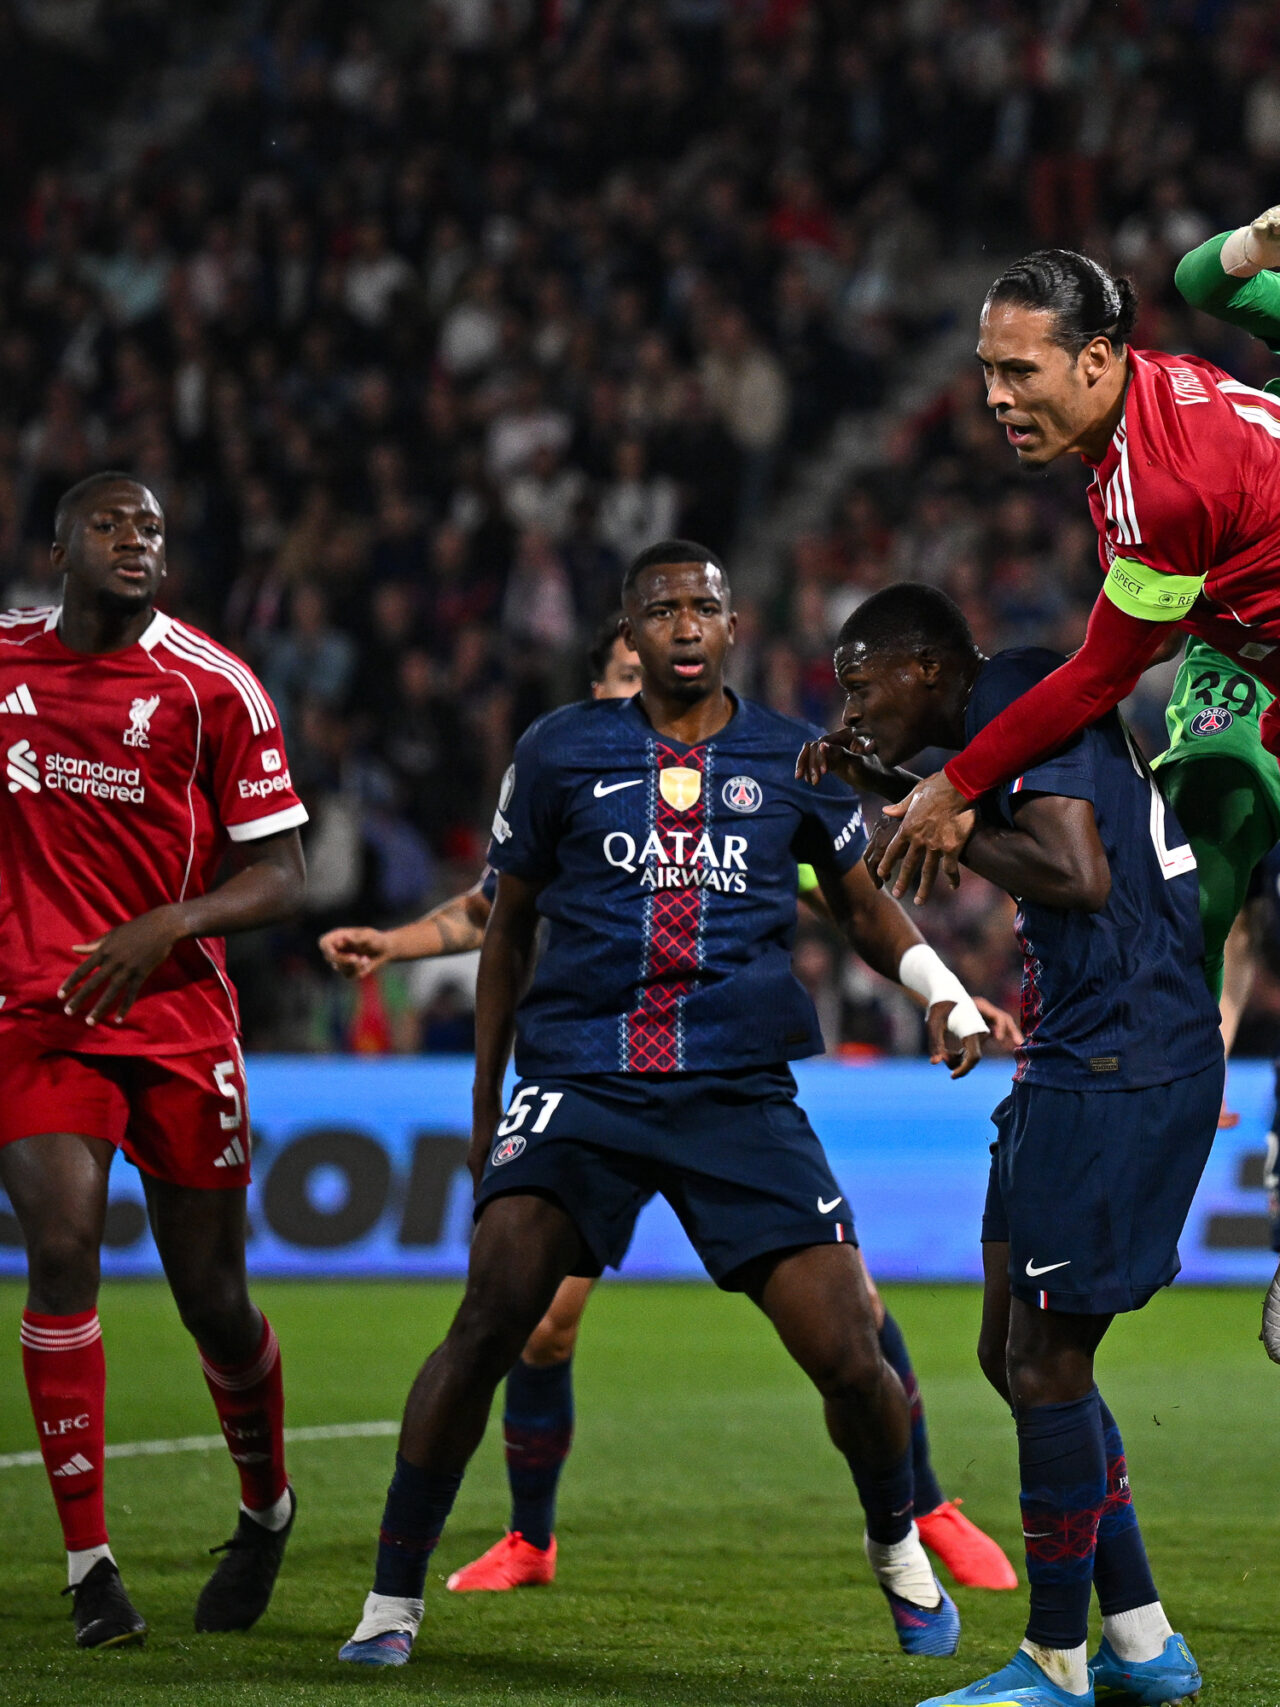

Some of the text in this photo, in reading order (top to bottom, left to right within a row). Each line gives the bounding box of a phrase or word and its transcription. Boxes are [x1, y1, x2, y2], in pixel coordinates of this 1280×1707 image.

[1200, 708, 1227, 718] PARIS
[45, 752, 140, 786] standard
[45, 772, 145, 804] chartered
[603, 829, 748, 874] QATAR
[639, 866, 747, 894] AIRWAYS
[212, 1059, 242, 1131] 5
[497, 1085, 564, 1137] 51
[43, 1413, 91, 1436] LFC
